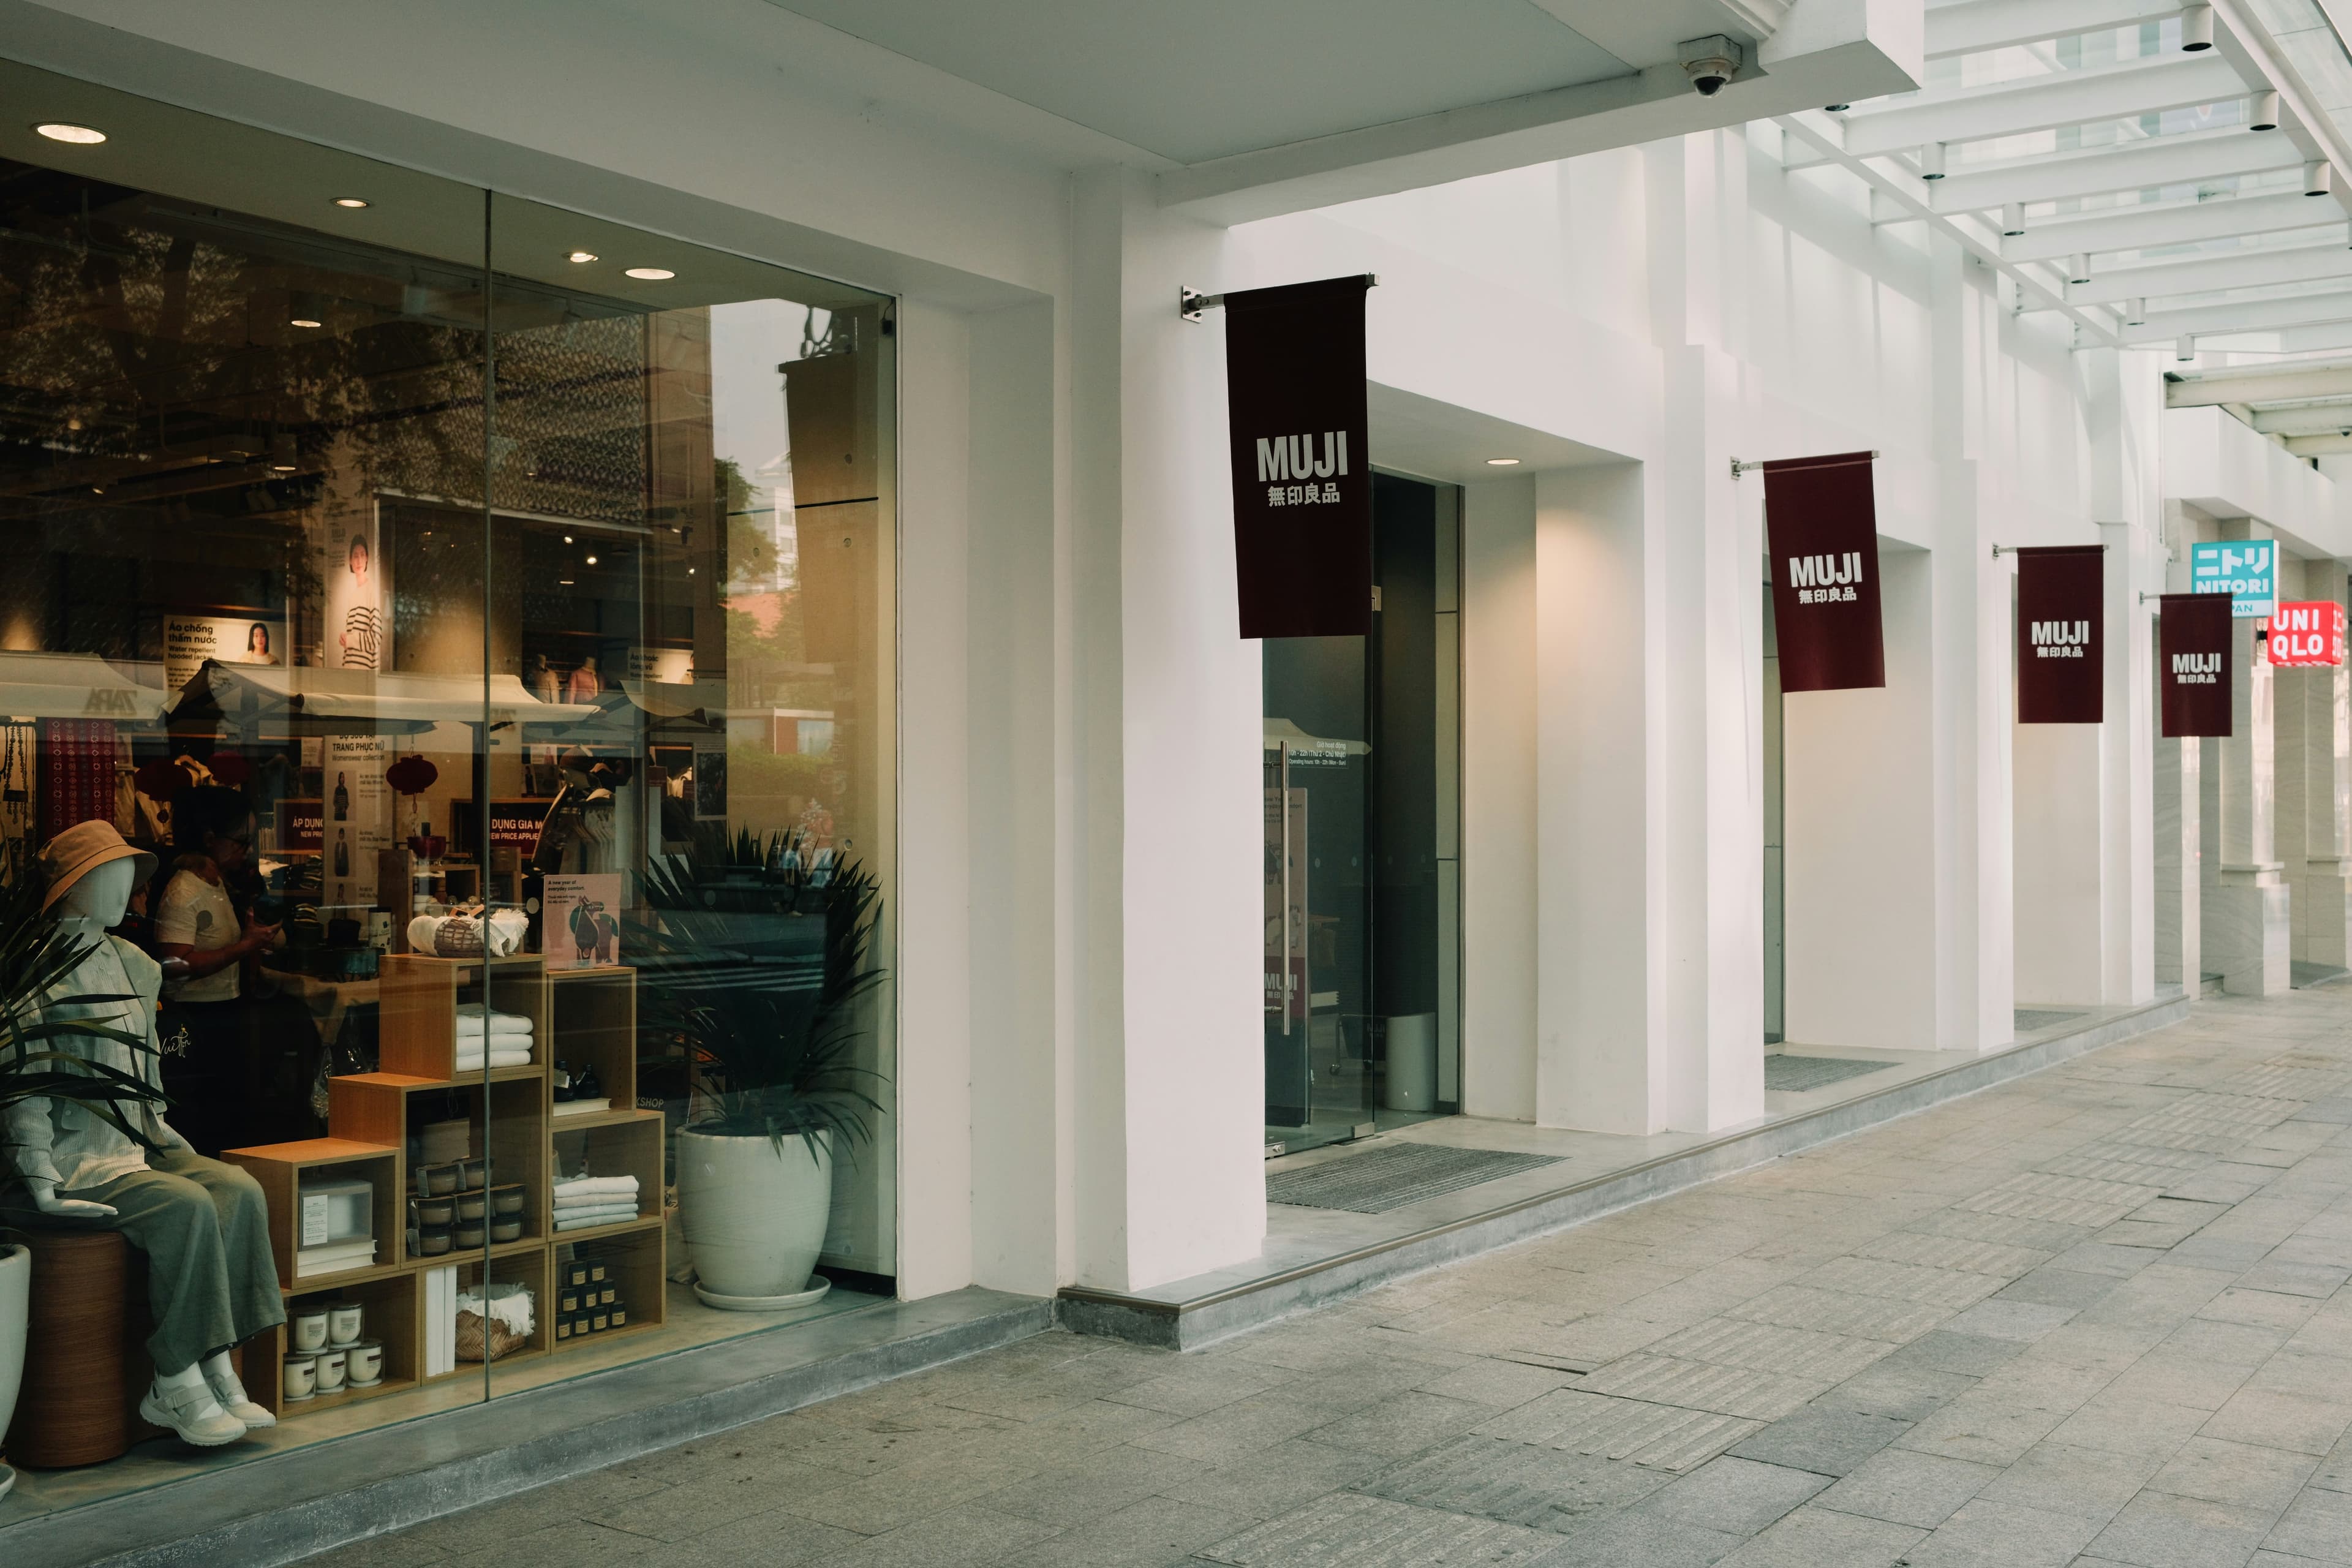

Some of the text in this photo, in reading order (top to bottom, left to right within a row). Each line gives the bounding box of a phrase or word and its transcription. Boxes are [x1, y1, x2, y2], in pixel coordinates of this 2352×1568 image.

[1256, 431, 1348, 482] MUJI
[1268, 482, 1340, 508] 無印良品
[1789, 551, 1863, 587] MUJI
[2196, 547, 2269, 576] ニトリ
[1798, 586, 1857, 605] 無印良品
[2196, 578, 2269, 594] NITORI
[168, 620, 213, 635] Áo chống
[2273, 609, 2320, 631] UNI
[168, 633, 217, 644] thấm nước
[2032, 620, 2089, 645] MUJI
[2037, 645, 2084, 658] 無印良品
[2273, 634, 2323, 660] QLO
[2173, 652, 2222, 674] MUJI
[2177, 673, 2217, 684] 無印良品
[356, 742, 373, 753] PHỤC
[293, 815, 303, 828] ÁP
[492, 818, 516, 832] DỤNG
